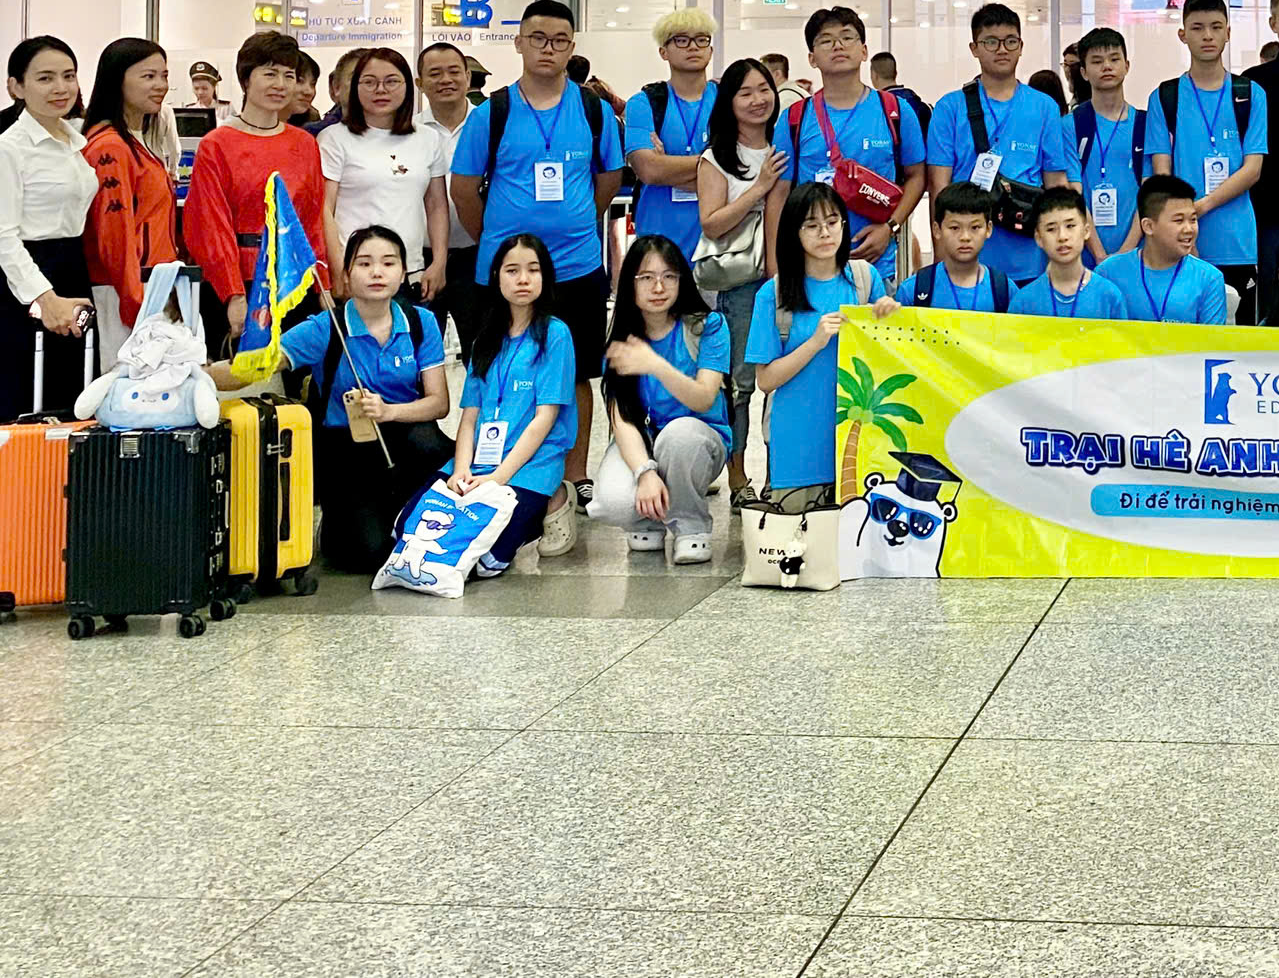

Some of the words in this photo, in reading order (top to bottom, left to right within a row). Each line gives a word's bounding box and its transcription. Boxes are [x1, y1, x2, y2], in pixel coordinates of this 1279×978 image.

[348, 31, 402, 42] Immigration
[480, 32, 514, 41] Entranc
[1020, 427, 1125, 475] TRẠI
[1131, 429, 1191, 473] HÈ
[1119, 491, 1140, 510] Đi
[1144, 487, 1169, 510] để
[1174, 490, 1206, 510] trải
